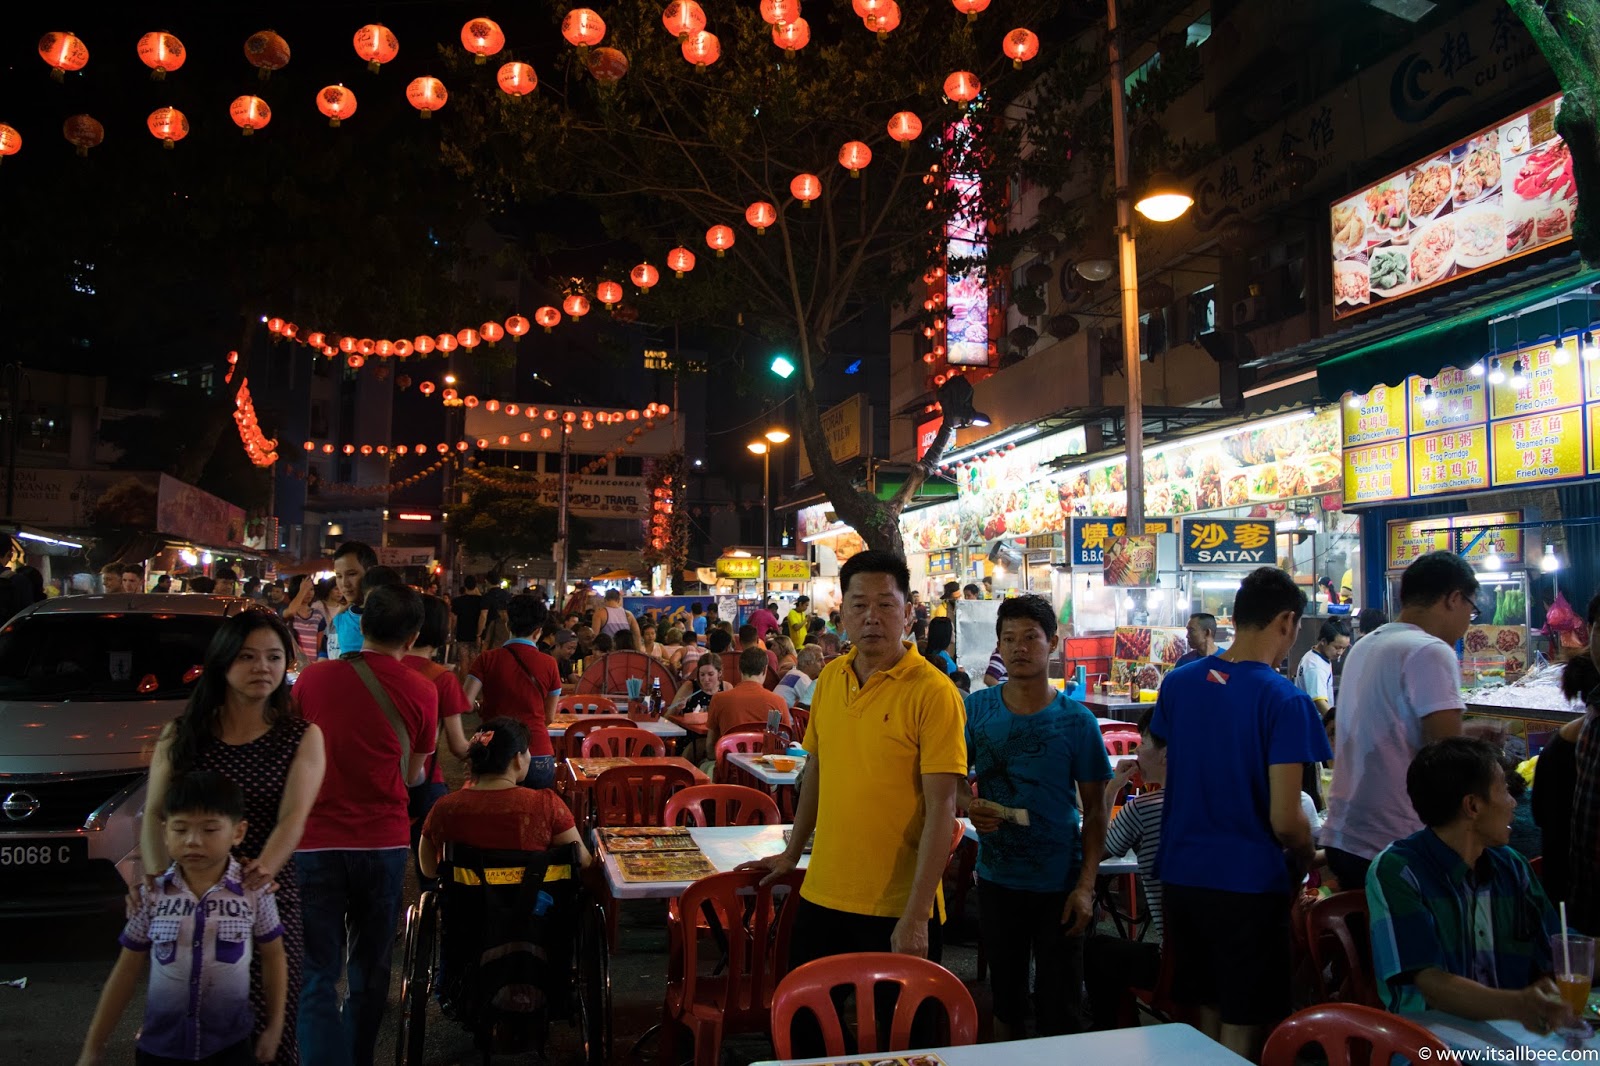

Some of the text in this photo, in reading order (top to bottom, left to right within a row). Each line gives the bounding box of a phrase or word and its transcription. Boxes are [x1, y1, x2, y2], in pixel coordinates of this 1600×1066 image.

[1475, 65, 1496, 86] CU
[1242, 197, 1255, 209] CU
[1535, 369, 1552, 377] Fish
[1450, 387, 1464, 397] Kway
[1466, 384, 1480, 392] Teow
[1361, 405, 1384, 415] Satay
[1515, 397, 1558, 411] Fried Oyster
[1442, 413, 1469, 424] Goreng
[1512, 417, 1562, 439] 清蒸鱼
[1362, 431, 1384, 440] Chicken
[1426, 432, 1471, 452] 田鸡粥
[1516, 437, 1559, 449] Steamed Fish
[1430, 450, 1468, 462] Frog Porridge
[1523, 449, 1553, 466] 炒菜
[1, 472, 36, 481] KDAI
[1517, 467, 1559, 477] Fried Vege
[1450, 479, 1470, 487] Chicken
[605, 496, 639, 505] TRAVEL
[1191, 523, 1271, 549] 沙爹
[1198, 551, 1264, 562] SATAY
[0, 846, 70, 865] 5068 C
